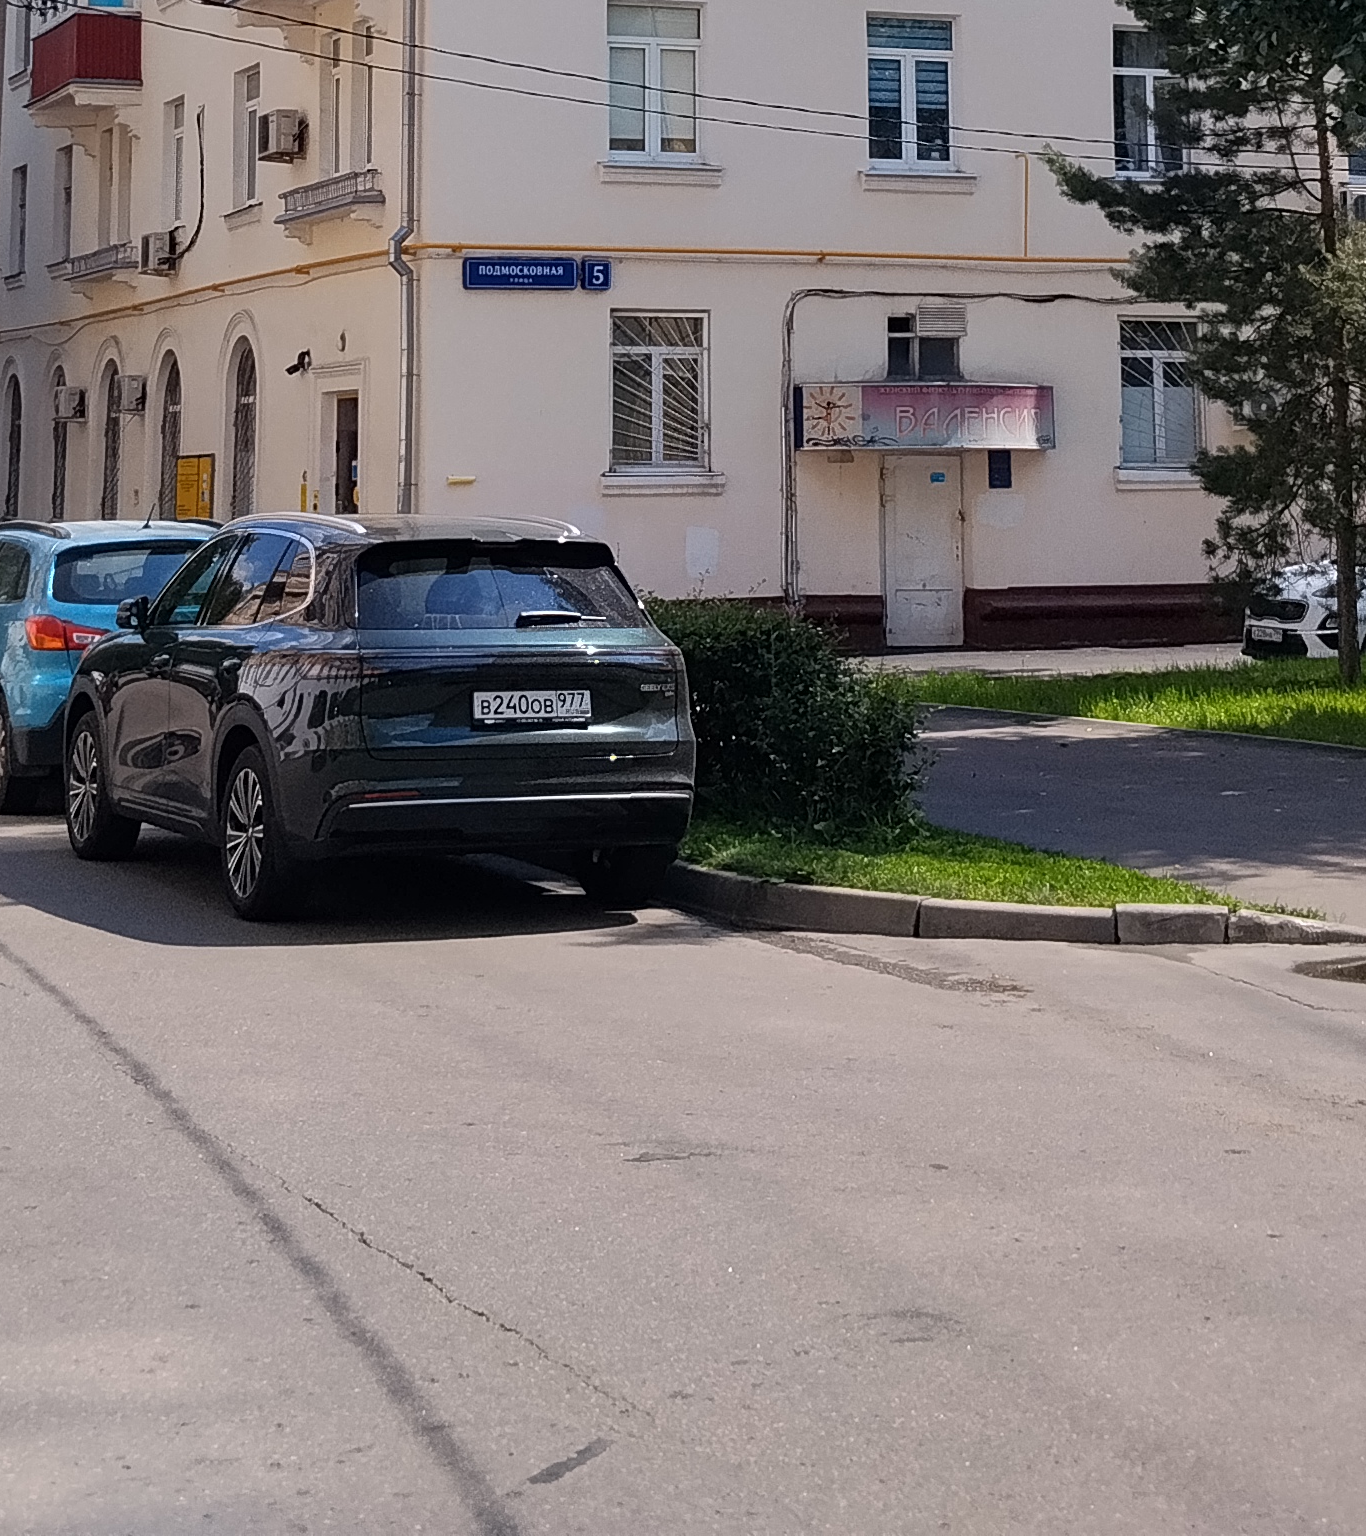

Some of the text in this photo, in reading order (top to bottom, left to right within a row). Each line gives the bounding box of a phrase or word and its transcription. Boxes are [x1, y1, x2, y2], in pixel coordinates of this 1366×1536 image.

[478, 265, 564, 276] ПОДМОСКОВНАЯ
[592, 265, 604, 285] 5
[895, 405, 1040, 438] ВАЛЕНСИЯ
[480, 692, 585, 715] В240ОВ 977
